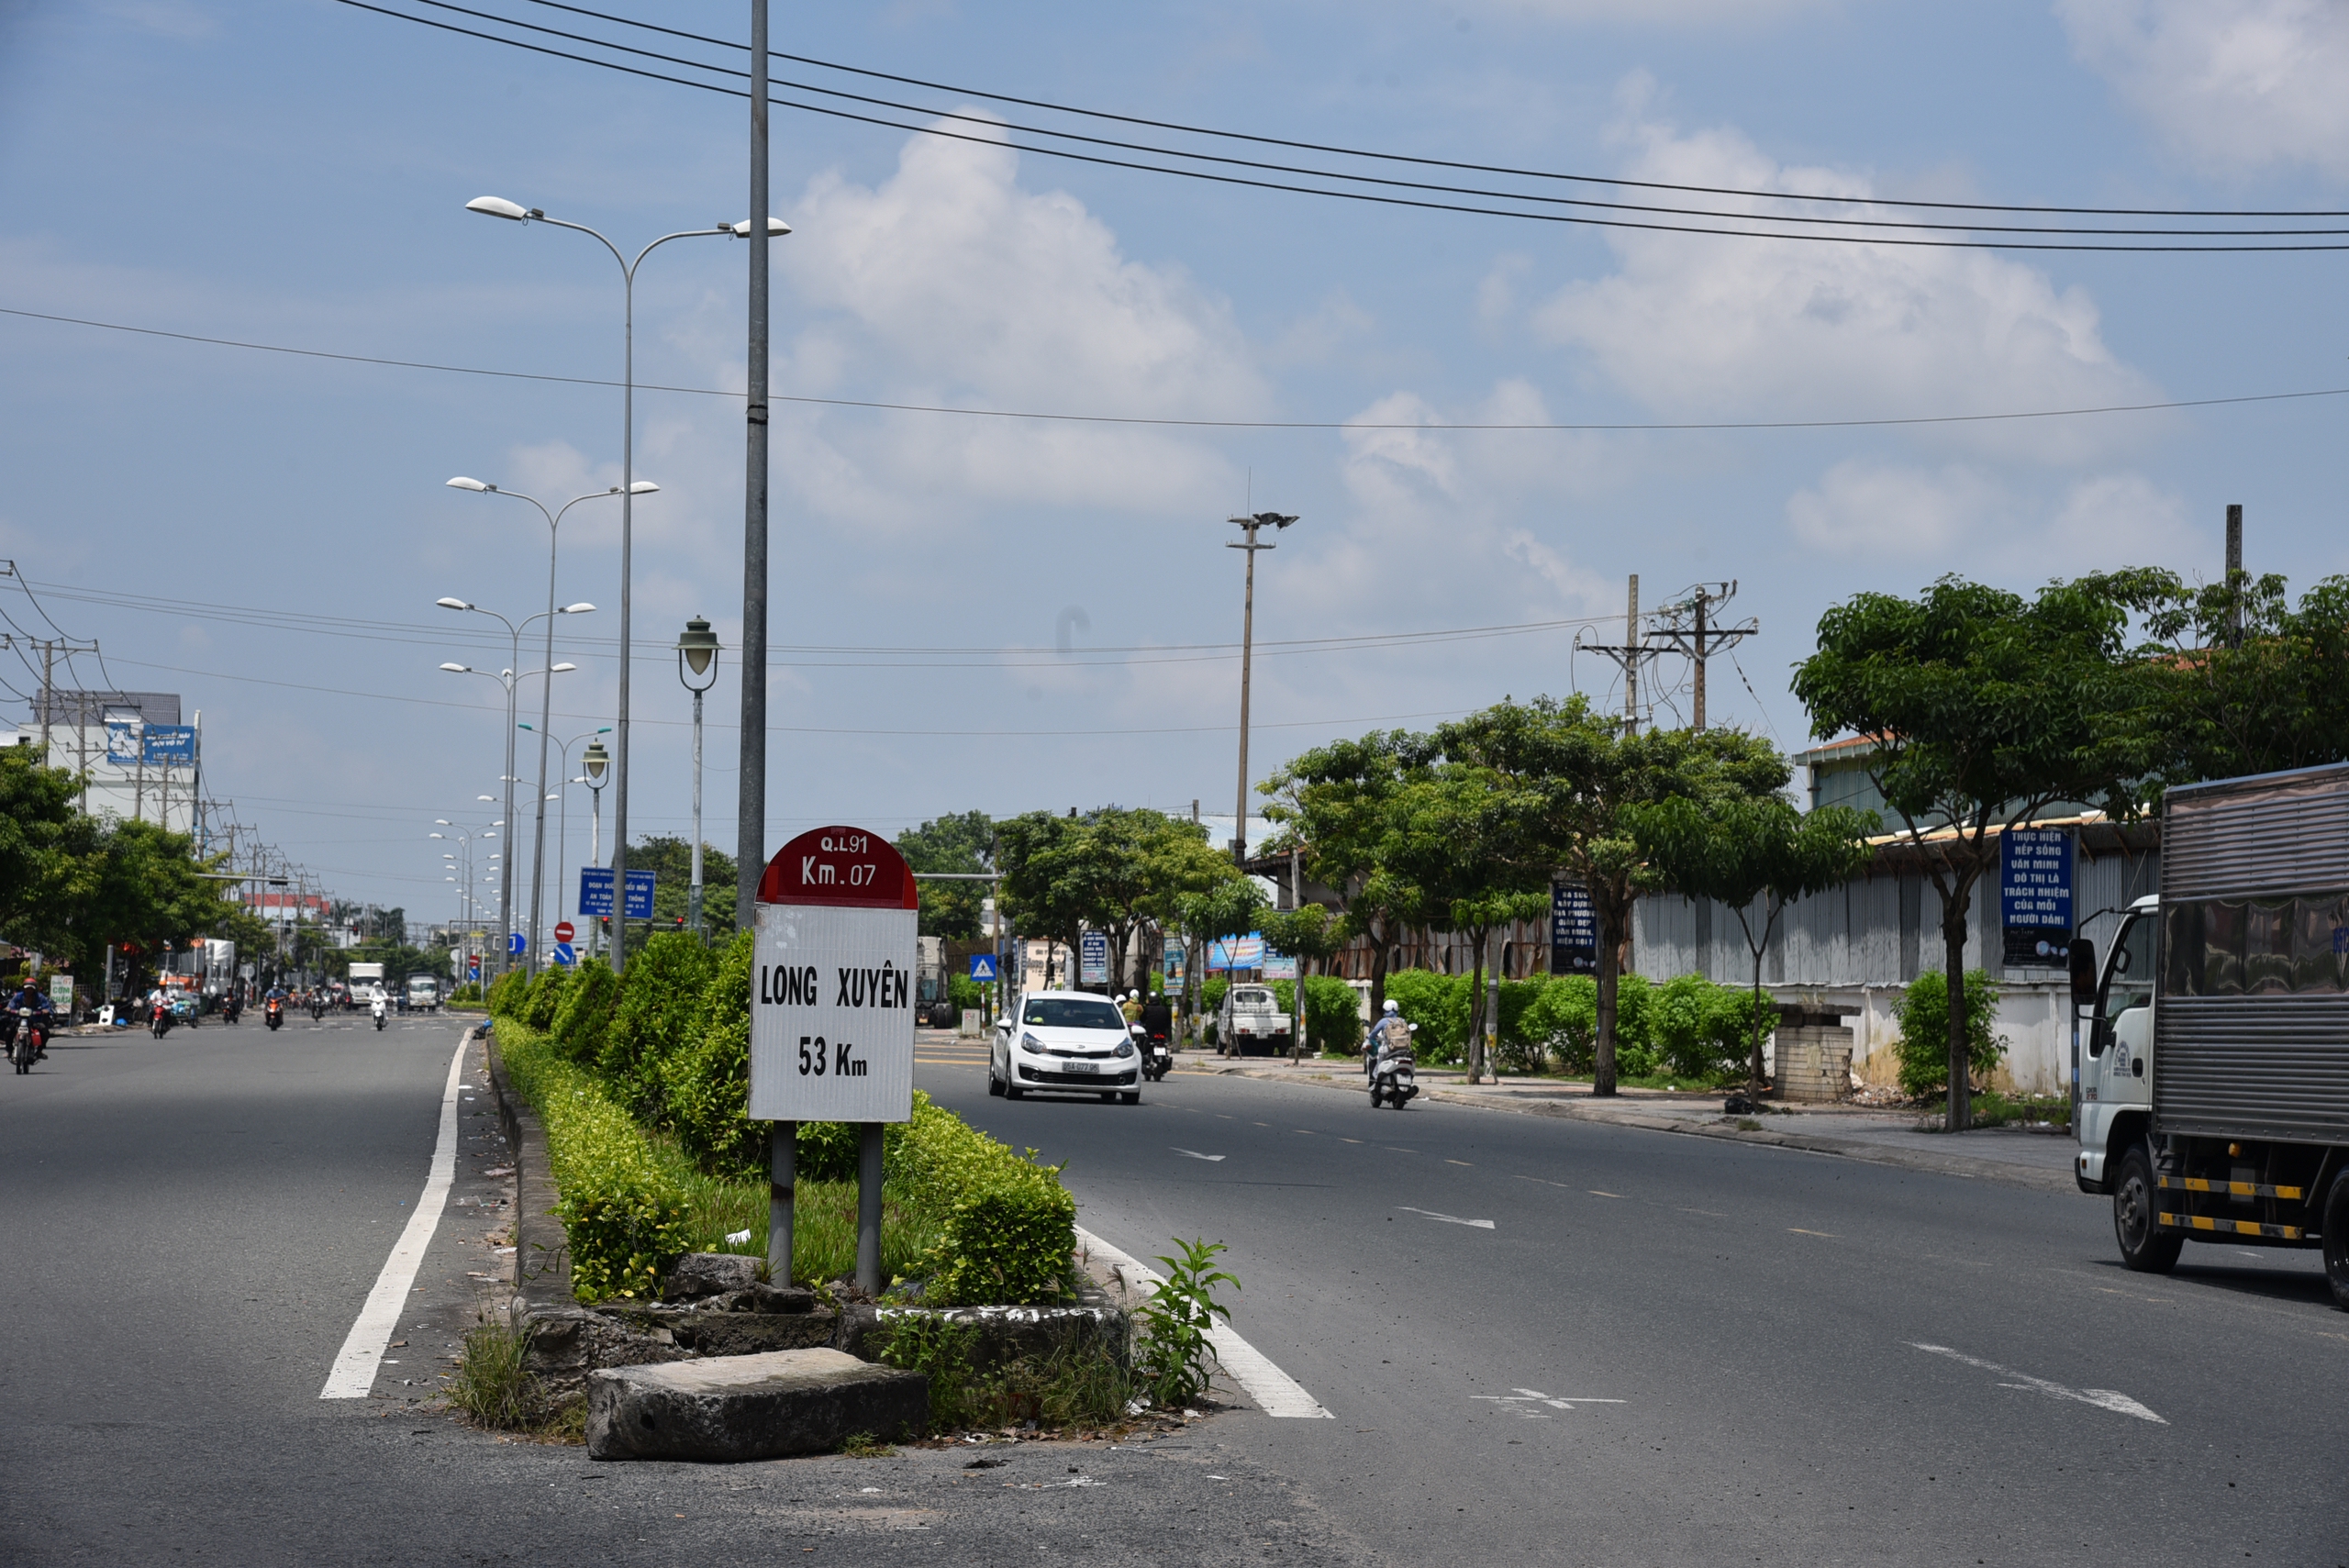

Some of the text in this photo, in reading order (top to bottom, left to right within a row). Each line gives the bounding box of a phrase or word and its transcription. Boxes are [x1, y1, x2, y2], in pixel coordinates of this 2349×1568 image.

[2012, 831, 2062, 843] THỰC HIỆN
[2015, 843, 2062, 856] NẾP SỐNG
[2011, 859, 2059, 870] VĂN MINH
[2014, 873, 2060, 885] ĐÔ THỊ LÀ
[2004, 885, 2070, 899] TRÁCH NHIỆM
[2014, 899, 2056, 911] CỦA MỖI
[2009, 913, 2039, 924] NGƯỜI
[761, 960, 908, 1009] LONG XUYÊN
[798, 1036, 867, 1076] 53 Km
